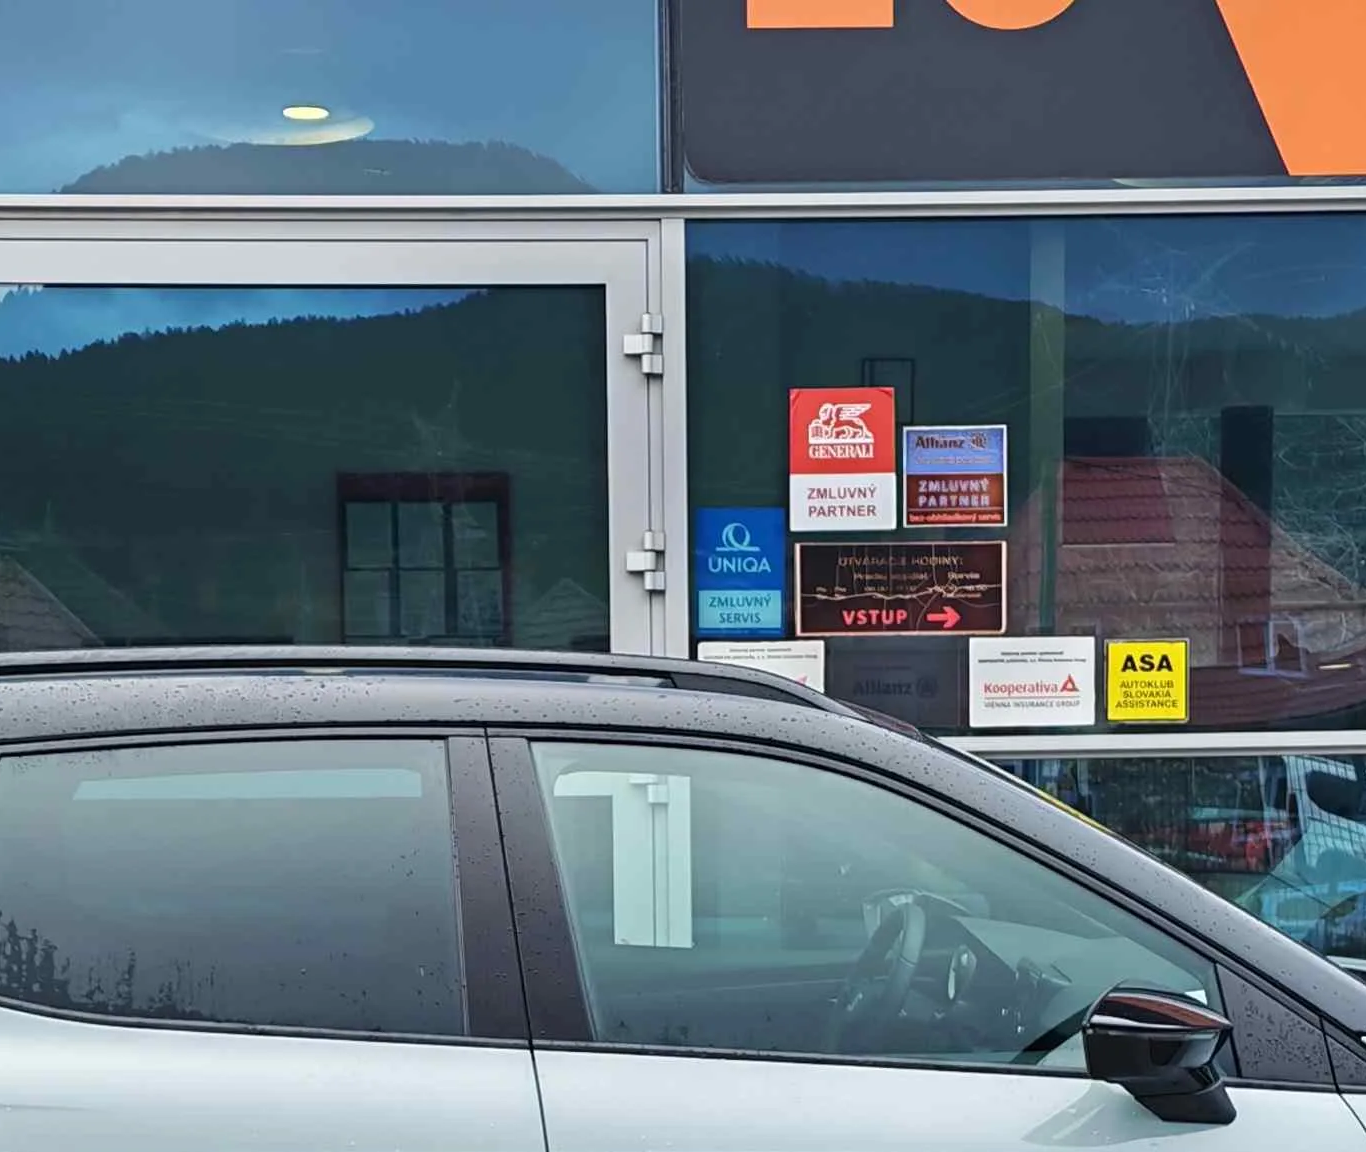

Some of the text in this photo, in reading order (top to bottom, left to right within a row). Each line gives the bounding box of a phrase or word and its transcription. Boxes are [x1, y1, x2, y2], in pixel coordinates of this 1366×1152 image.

[916, 435, 965, 449] Allianz
[808, 444, 875, 459] GENERALI
[807, 483, 877, 500] ZMLUVNÝ
[918, 495, 990, 508] PARTNER
[808, 504, 877, 518] PARTNER
[708, 556, 772, 573] UNIQA
[708, 594, 772, 608] ZMLUVNÝ
[719, 612, 761, 624] SERVIS
[842, 610, 908, 625] VSTUP
[1121, 653, 1174, 672] ASA
[983, 681, 1058, 696] Kooperativa
[1119, 680, 1174, 688] AUTOKLUB
[1123, 690, 1172, 698] SLOVAKIA
[1115, 700, 1179, 708] ASSISTANCE
